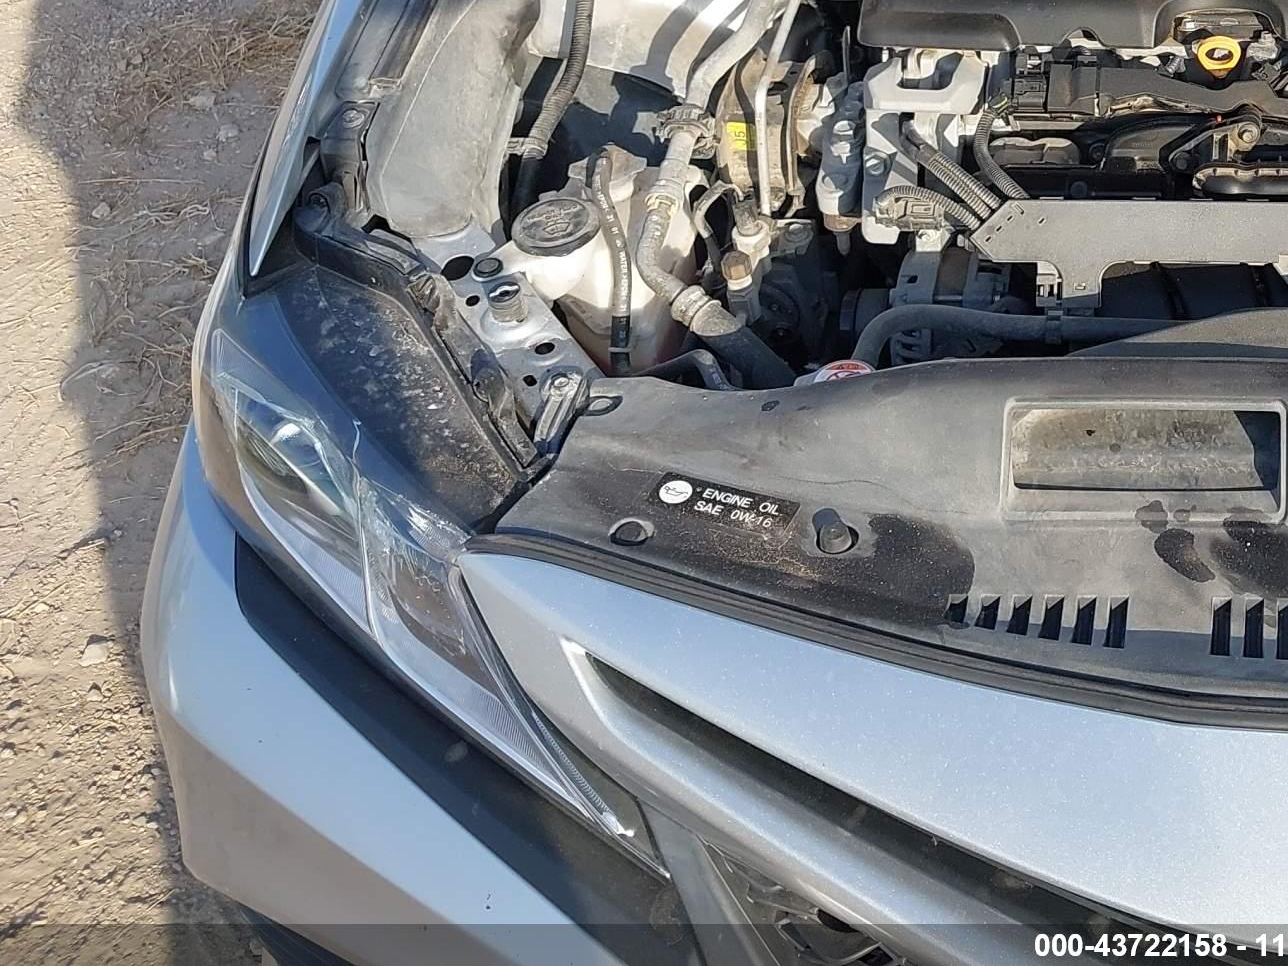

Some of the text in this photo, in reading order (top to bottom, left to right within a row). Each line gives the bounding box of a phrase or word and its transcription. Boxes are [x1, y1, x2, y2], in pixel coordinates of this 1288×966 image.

[694, 500, 725, 516] SAE
[702, 488, 781, 516] ENGINE OIL
